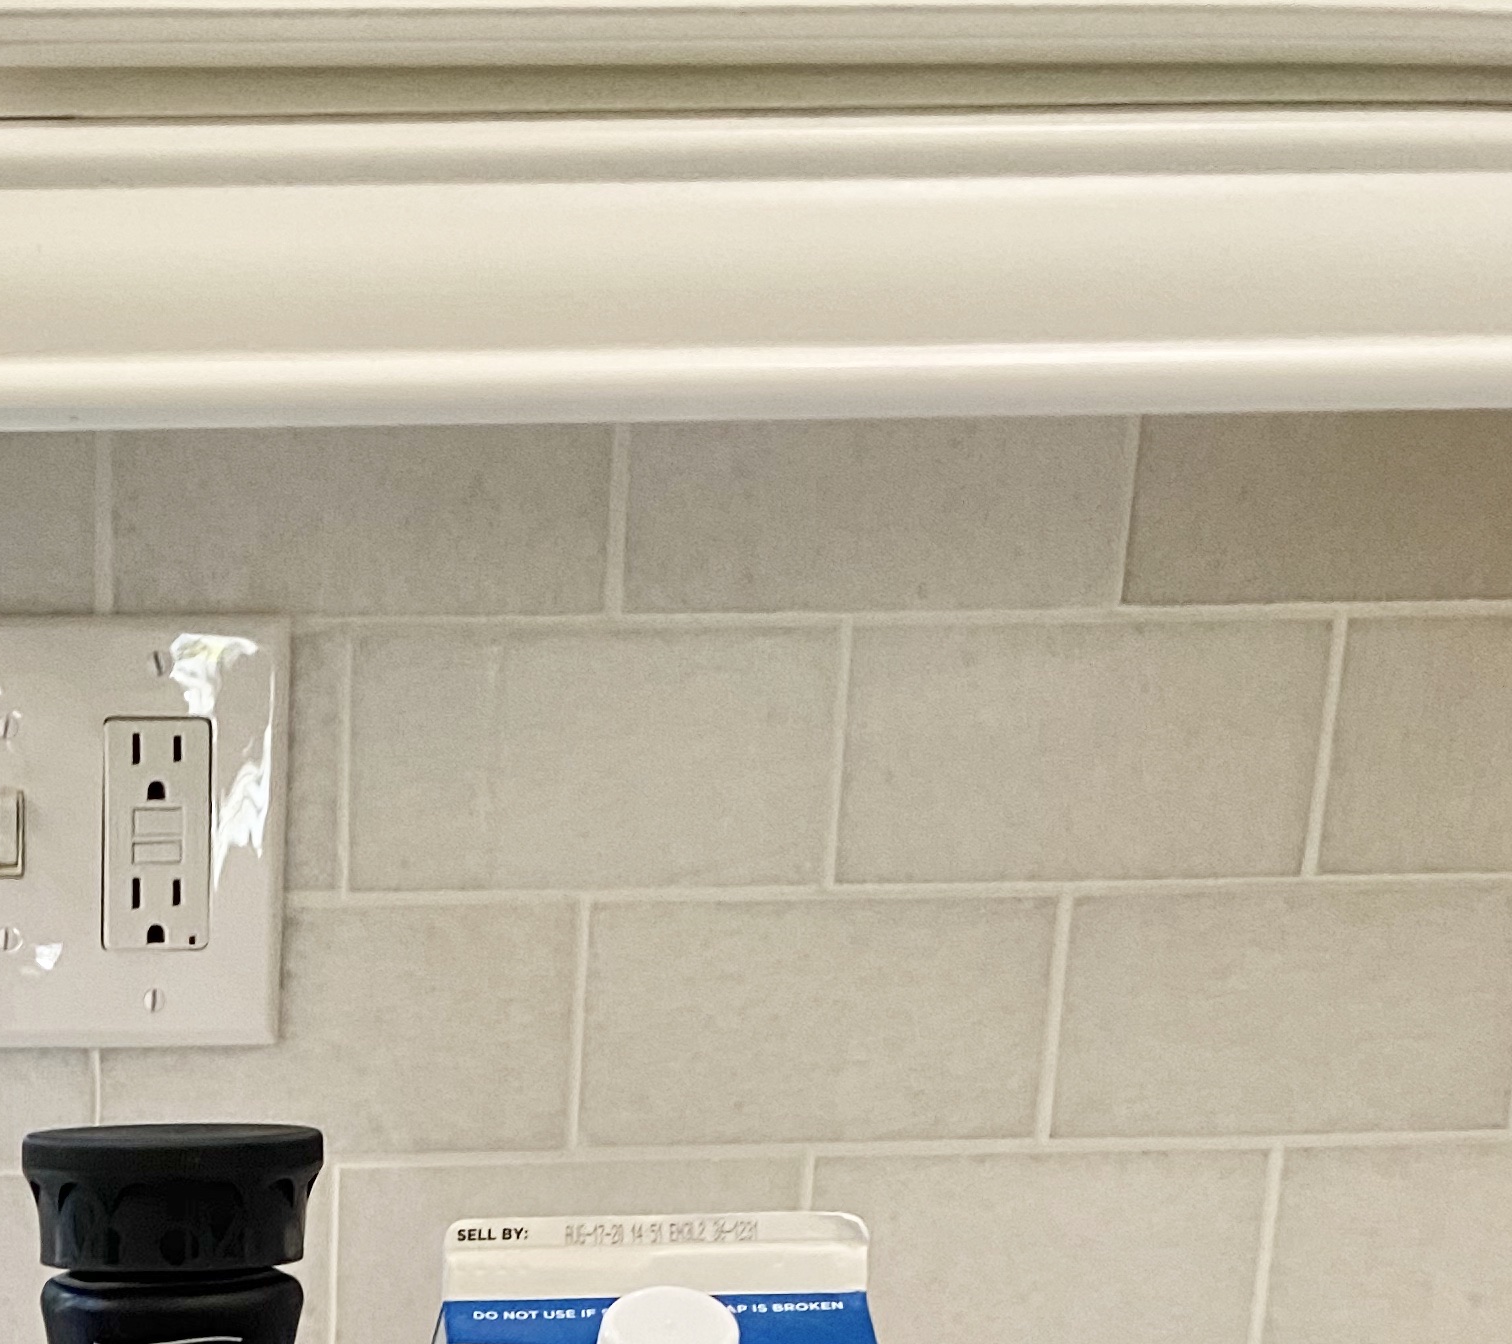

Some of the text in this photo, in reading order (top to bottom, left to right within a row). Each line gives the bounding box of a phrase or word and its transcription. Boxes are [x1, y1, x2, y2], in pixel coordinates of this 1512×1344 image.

[457, 1227, 529, 1241] SELL BY:
[472, 1310, 499, 1320] DO
[503, 1310, 538, 1320] NOT
[543, 1309, 576, 1319] USE
[581, 1308, 596, 1318] IF
[726, 1304, 748, 1314] AP
[752, 1303, 768, 1313] IS
[772, 1301, 844, 1313] BROKEN
